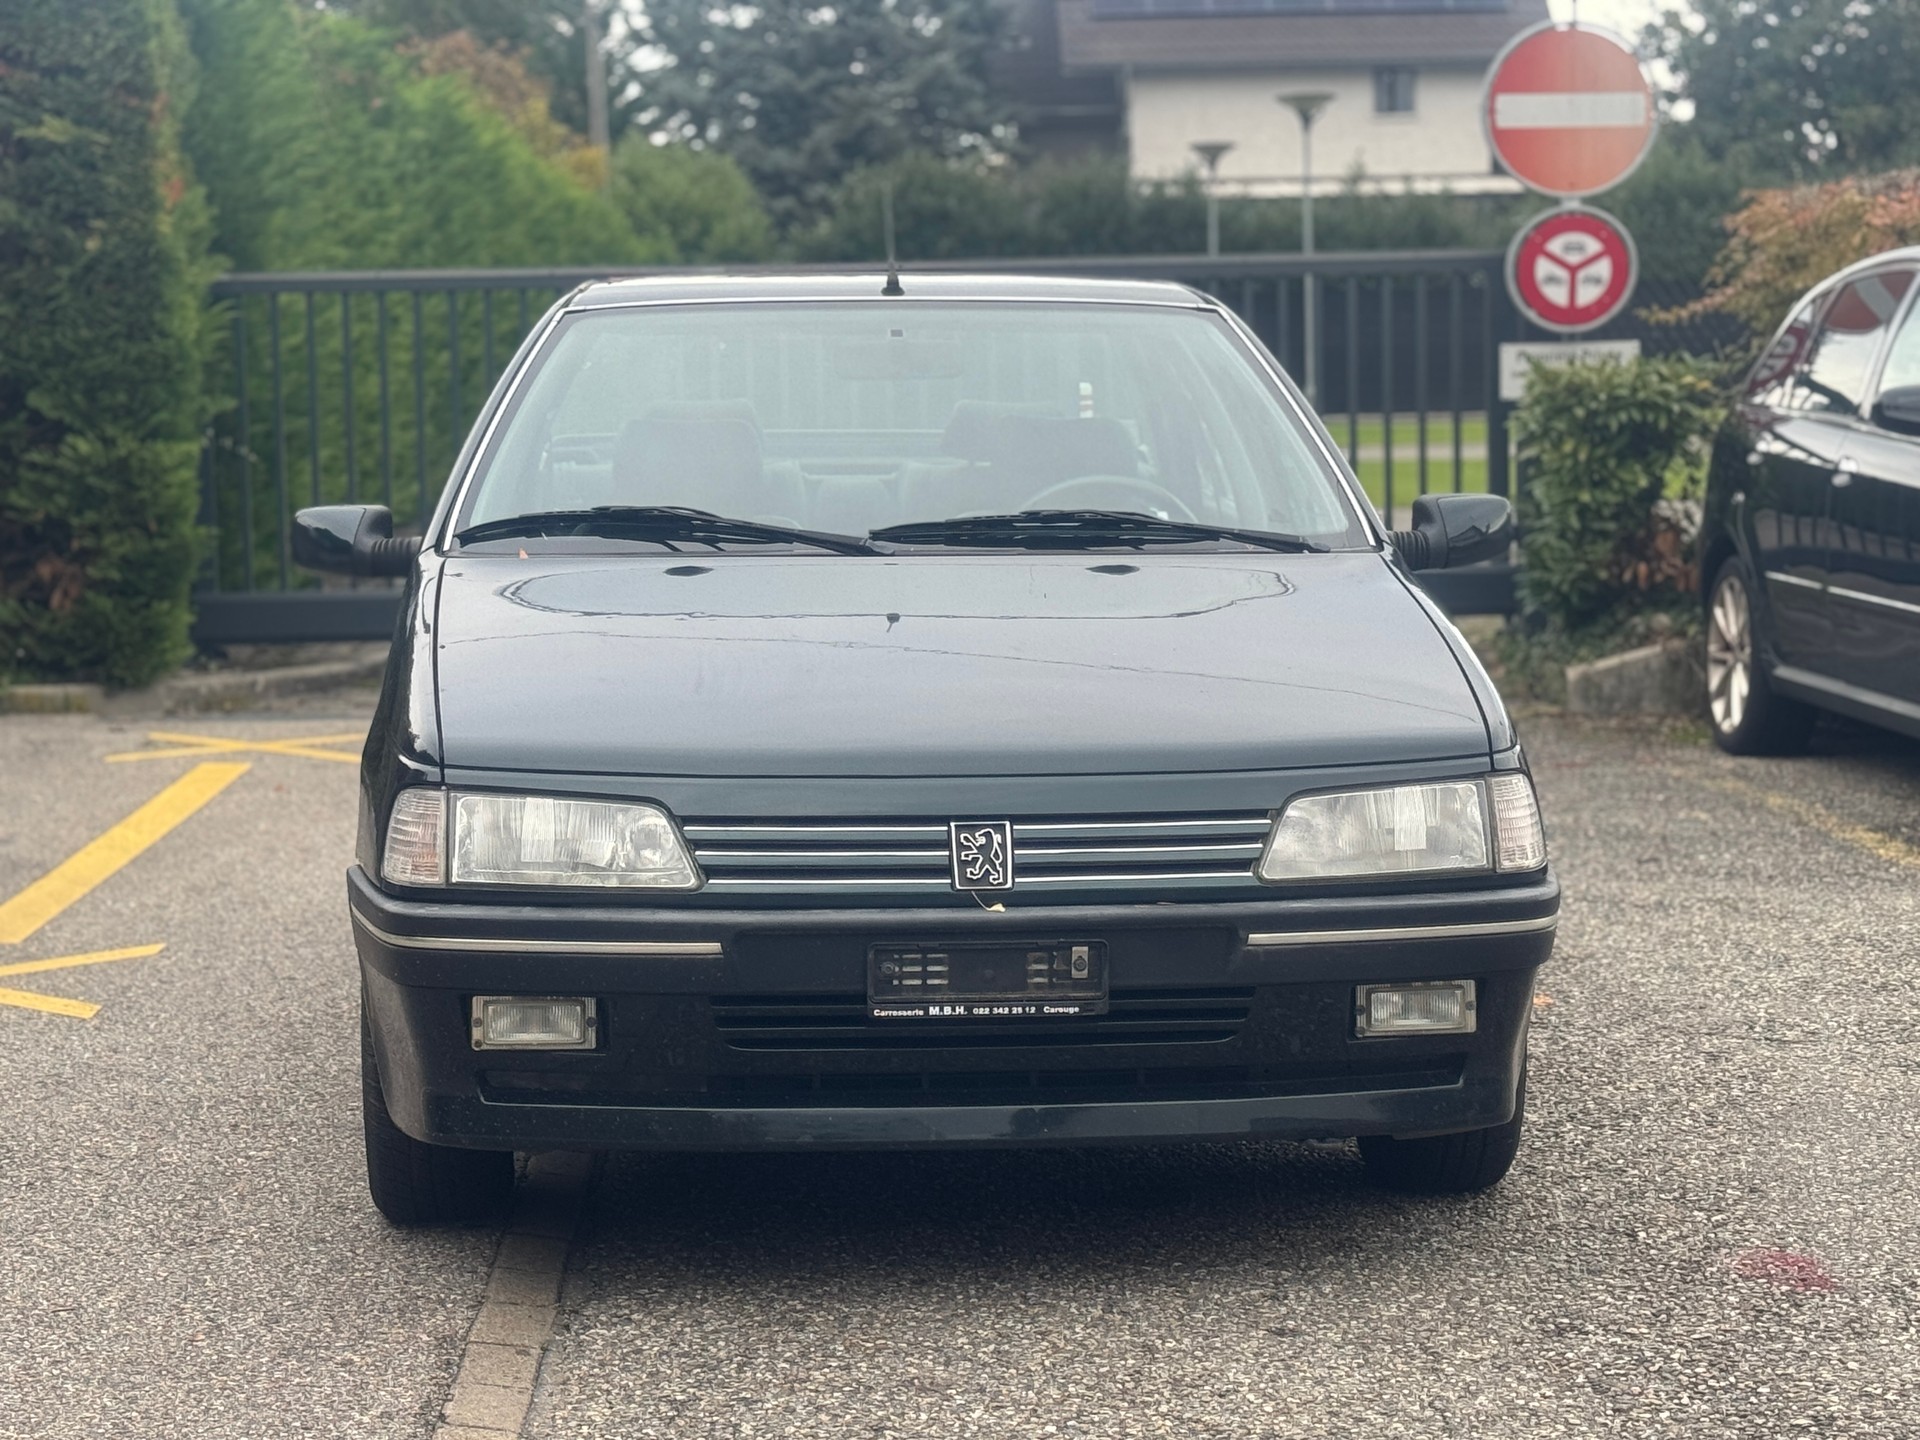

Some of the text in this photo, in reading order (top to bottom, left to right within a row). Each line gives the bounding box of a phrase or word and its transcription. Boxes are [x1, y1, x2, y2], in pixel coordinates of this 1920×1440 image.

[928, 1006, 968, 1016] M.B.H.
[972, 1007, 990, 1015] 022
[992, 1007, 1010, 1015] 342
[1025, 1006, 1036, 1014] 12
[1043, 1005, 1080, 1014] Carouge
